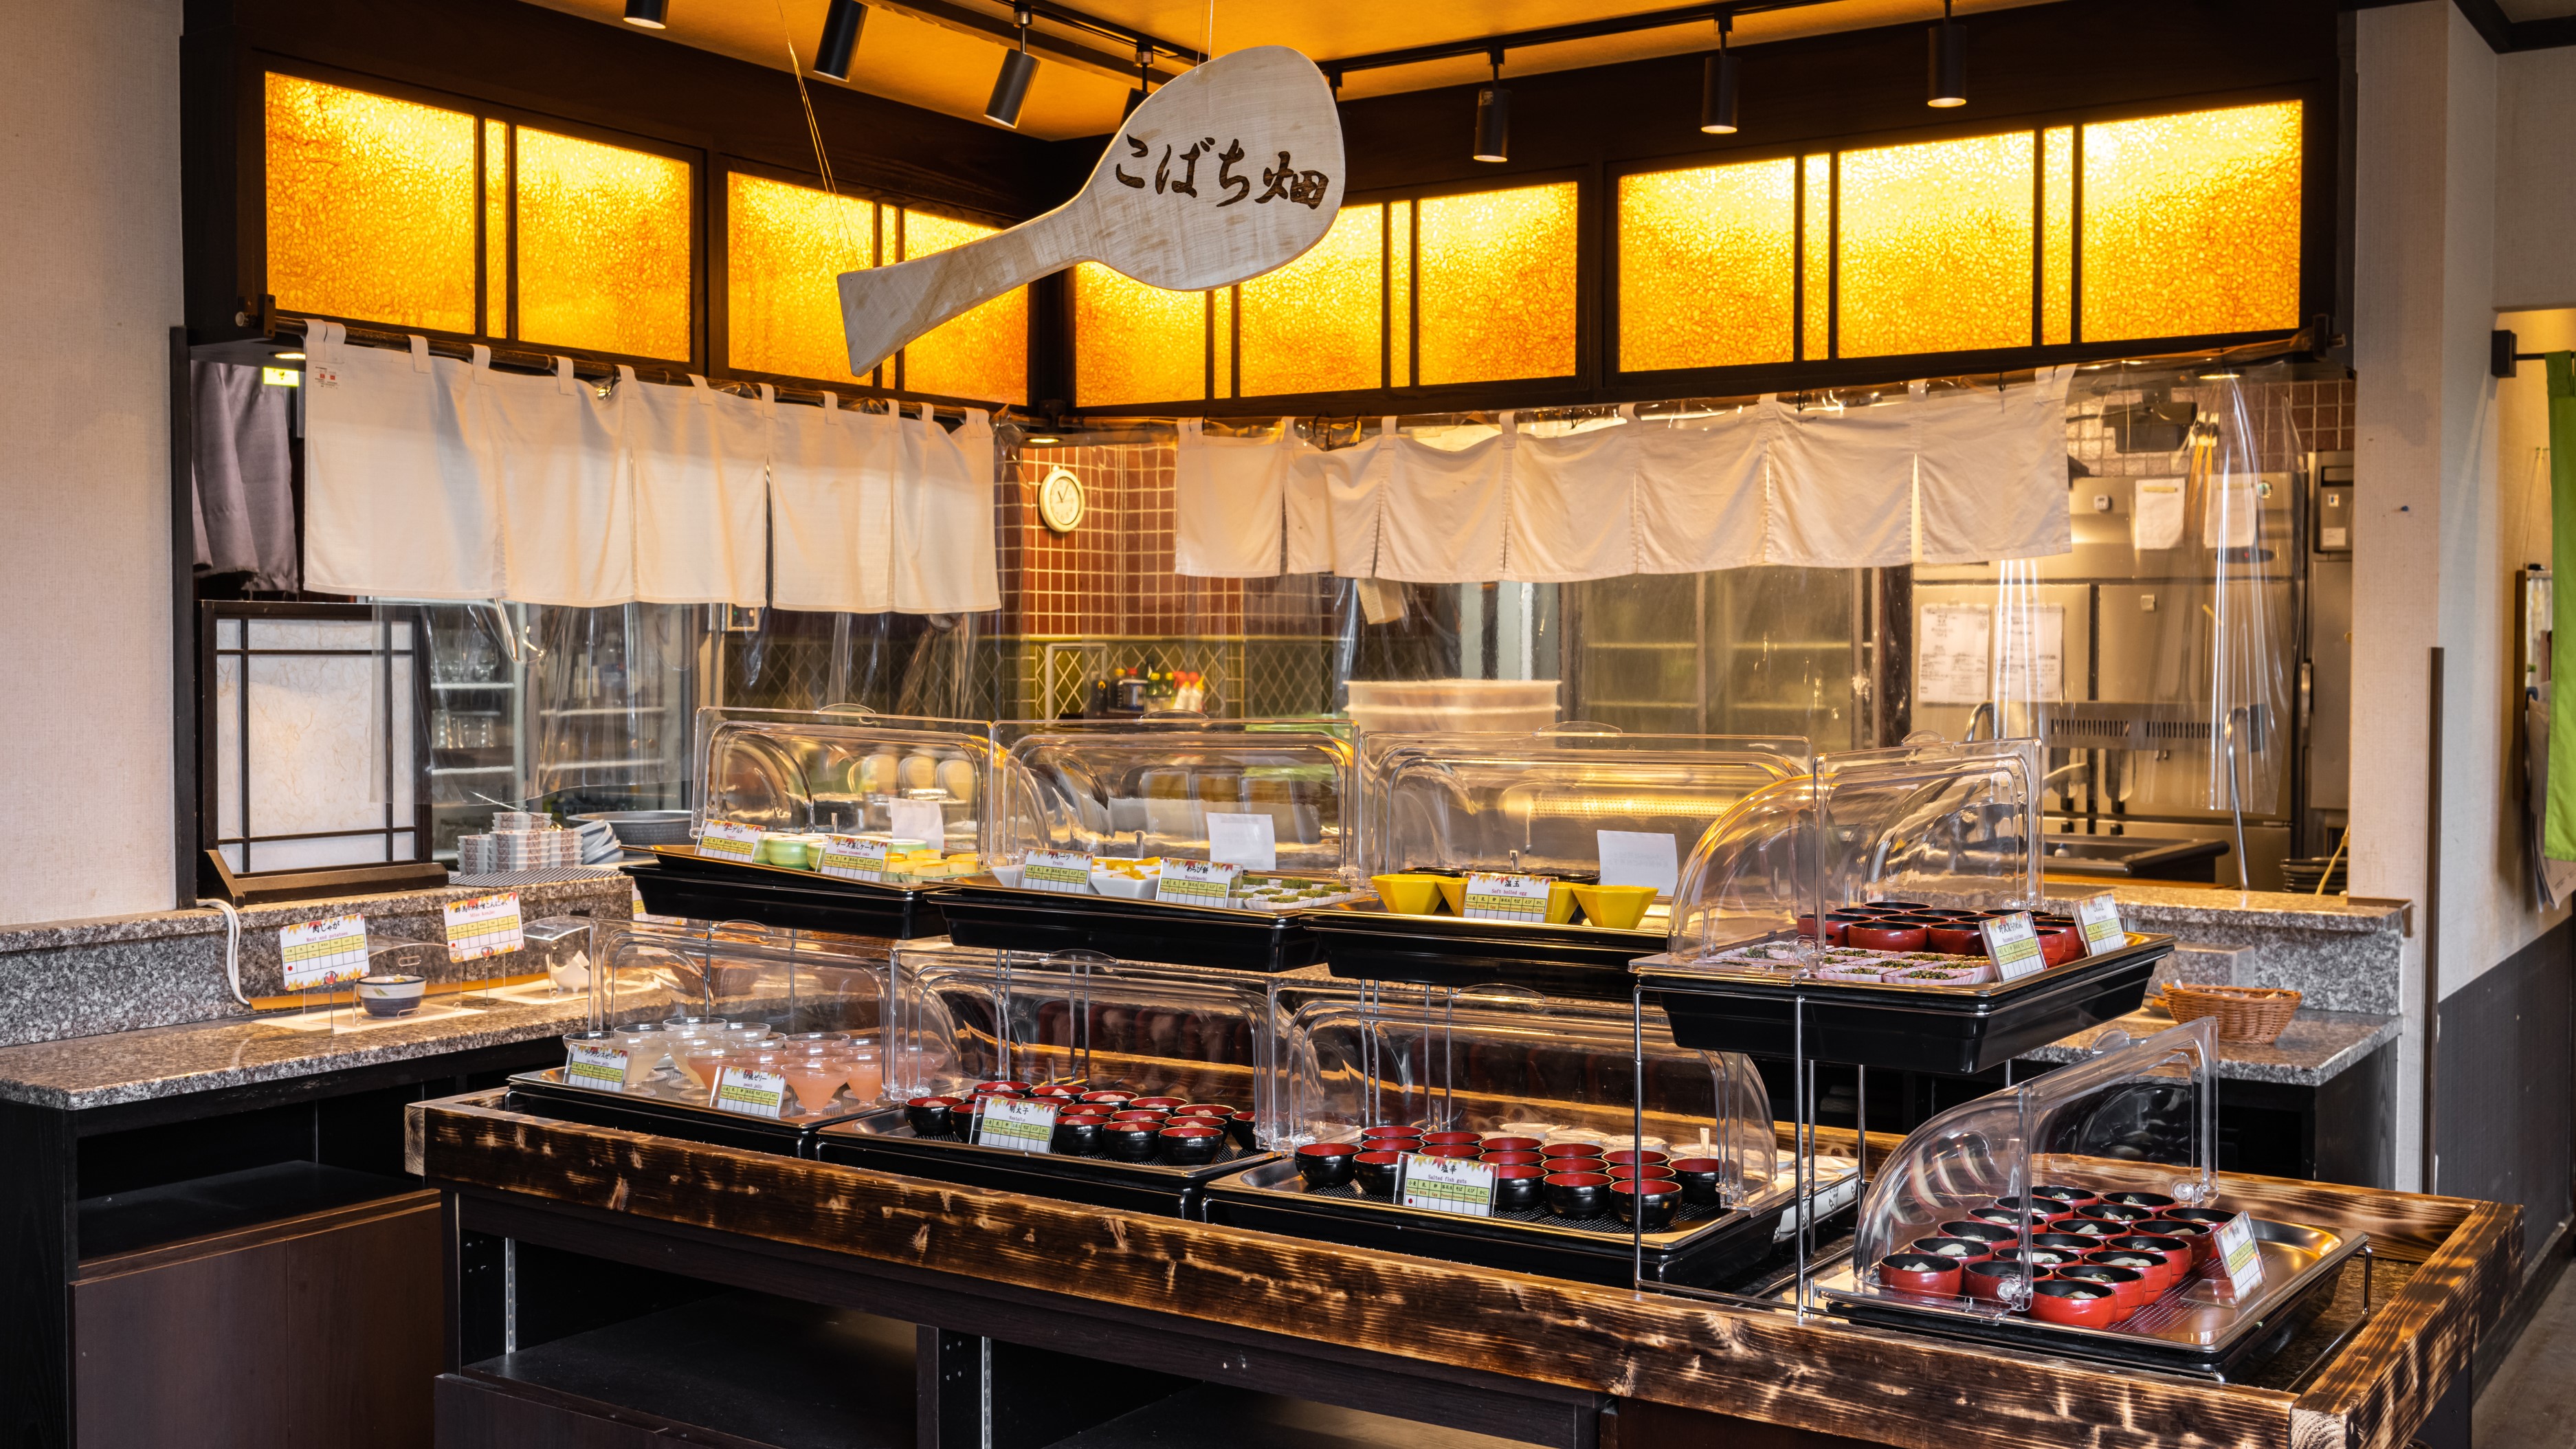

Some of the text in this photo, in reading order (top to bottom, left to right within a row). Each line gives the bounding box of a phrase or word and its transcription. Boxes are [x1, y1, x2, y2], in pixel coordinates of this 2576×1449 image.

[1115, 134, 1329, 210] こばち畑
[836, 841, 874, 851] チーズ蒸しケーキ
[1187, 865, 1208, 874] わらび餅
[313, 920, 340, 933] 肉じゃが
[1009, 1105, 1029, 1115] 明太子
[1441, 1164, 1457, 1175] 塩辛
